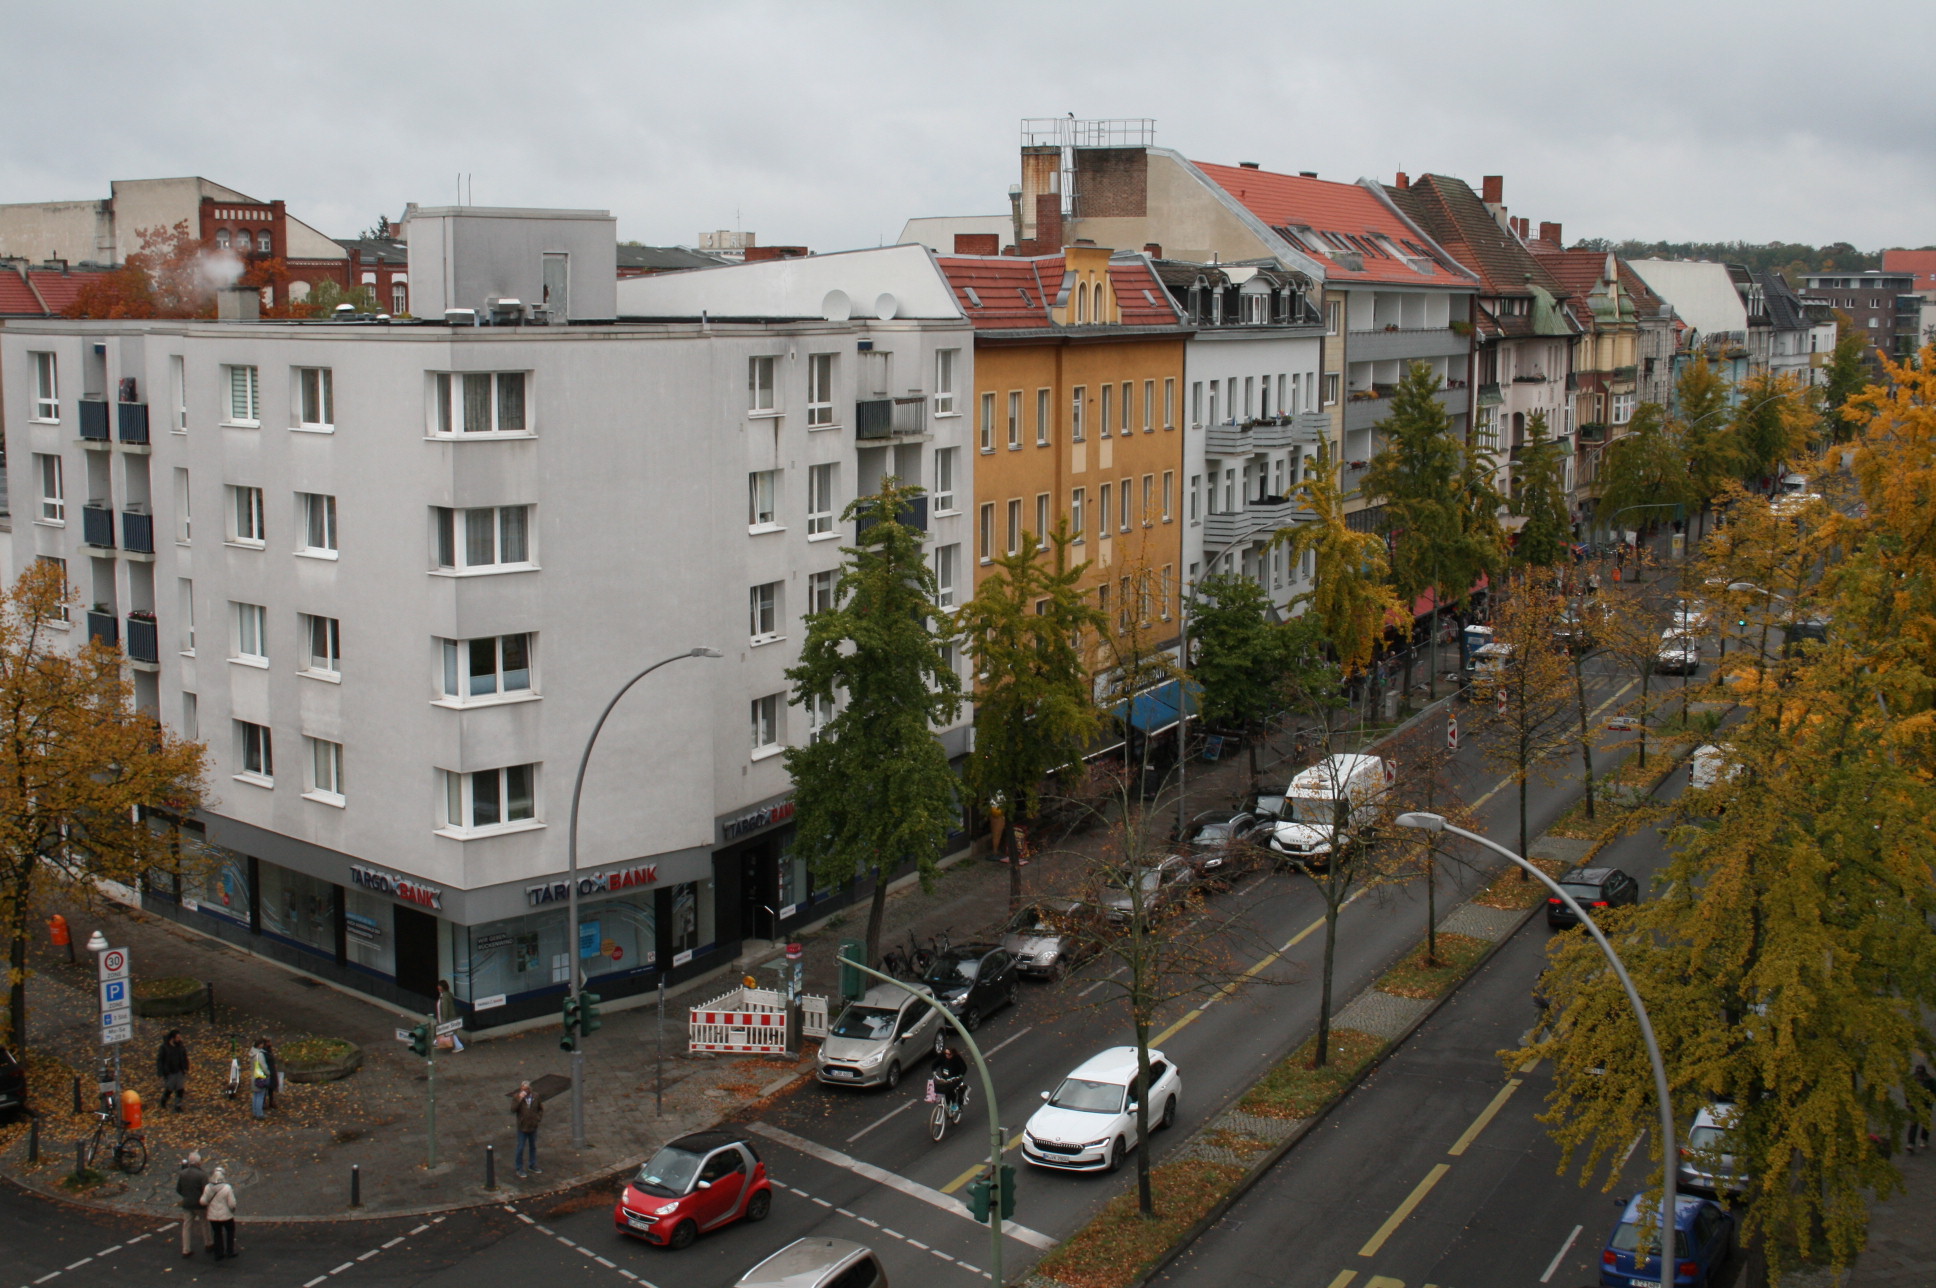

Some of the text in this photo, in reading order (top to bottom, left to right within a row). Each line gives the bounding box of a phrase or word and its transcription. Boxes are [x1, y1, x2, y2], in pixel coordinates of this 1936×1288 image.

[349, 864, 441, 910] TARGO BANK
[526, 863, 658, 906] TARO BANK
[108, 956, 120, 967] 30
[107, 971, 122, 979] ZONE
[109, 1001, 123, 1009] ZONE
